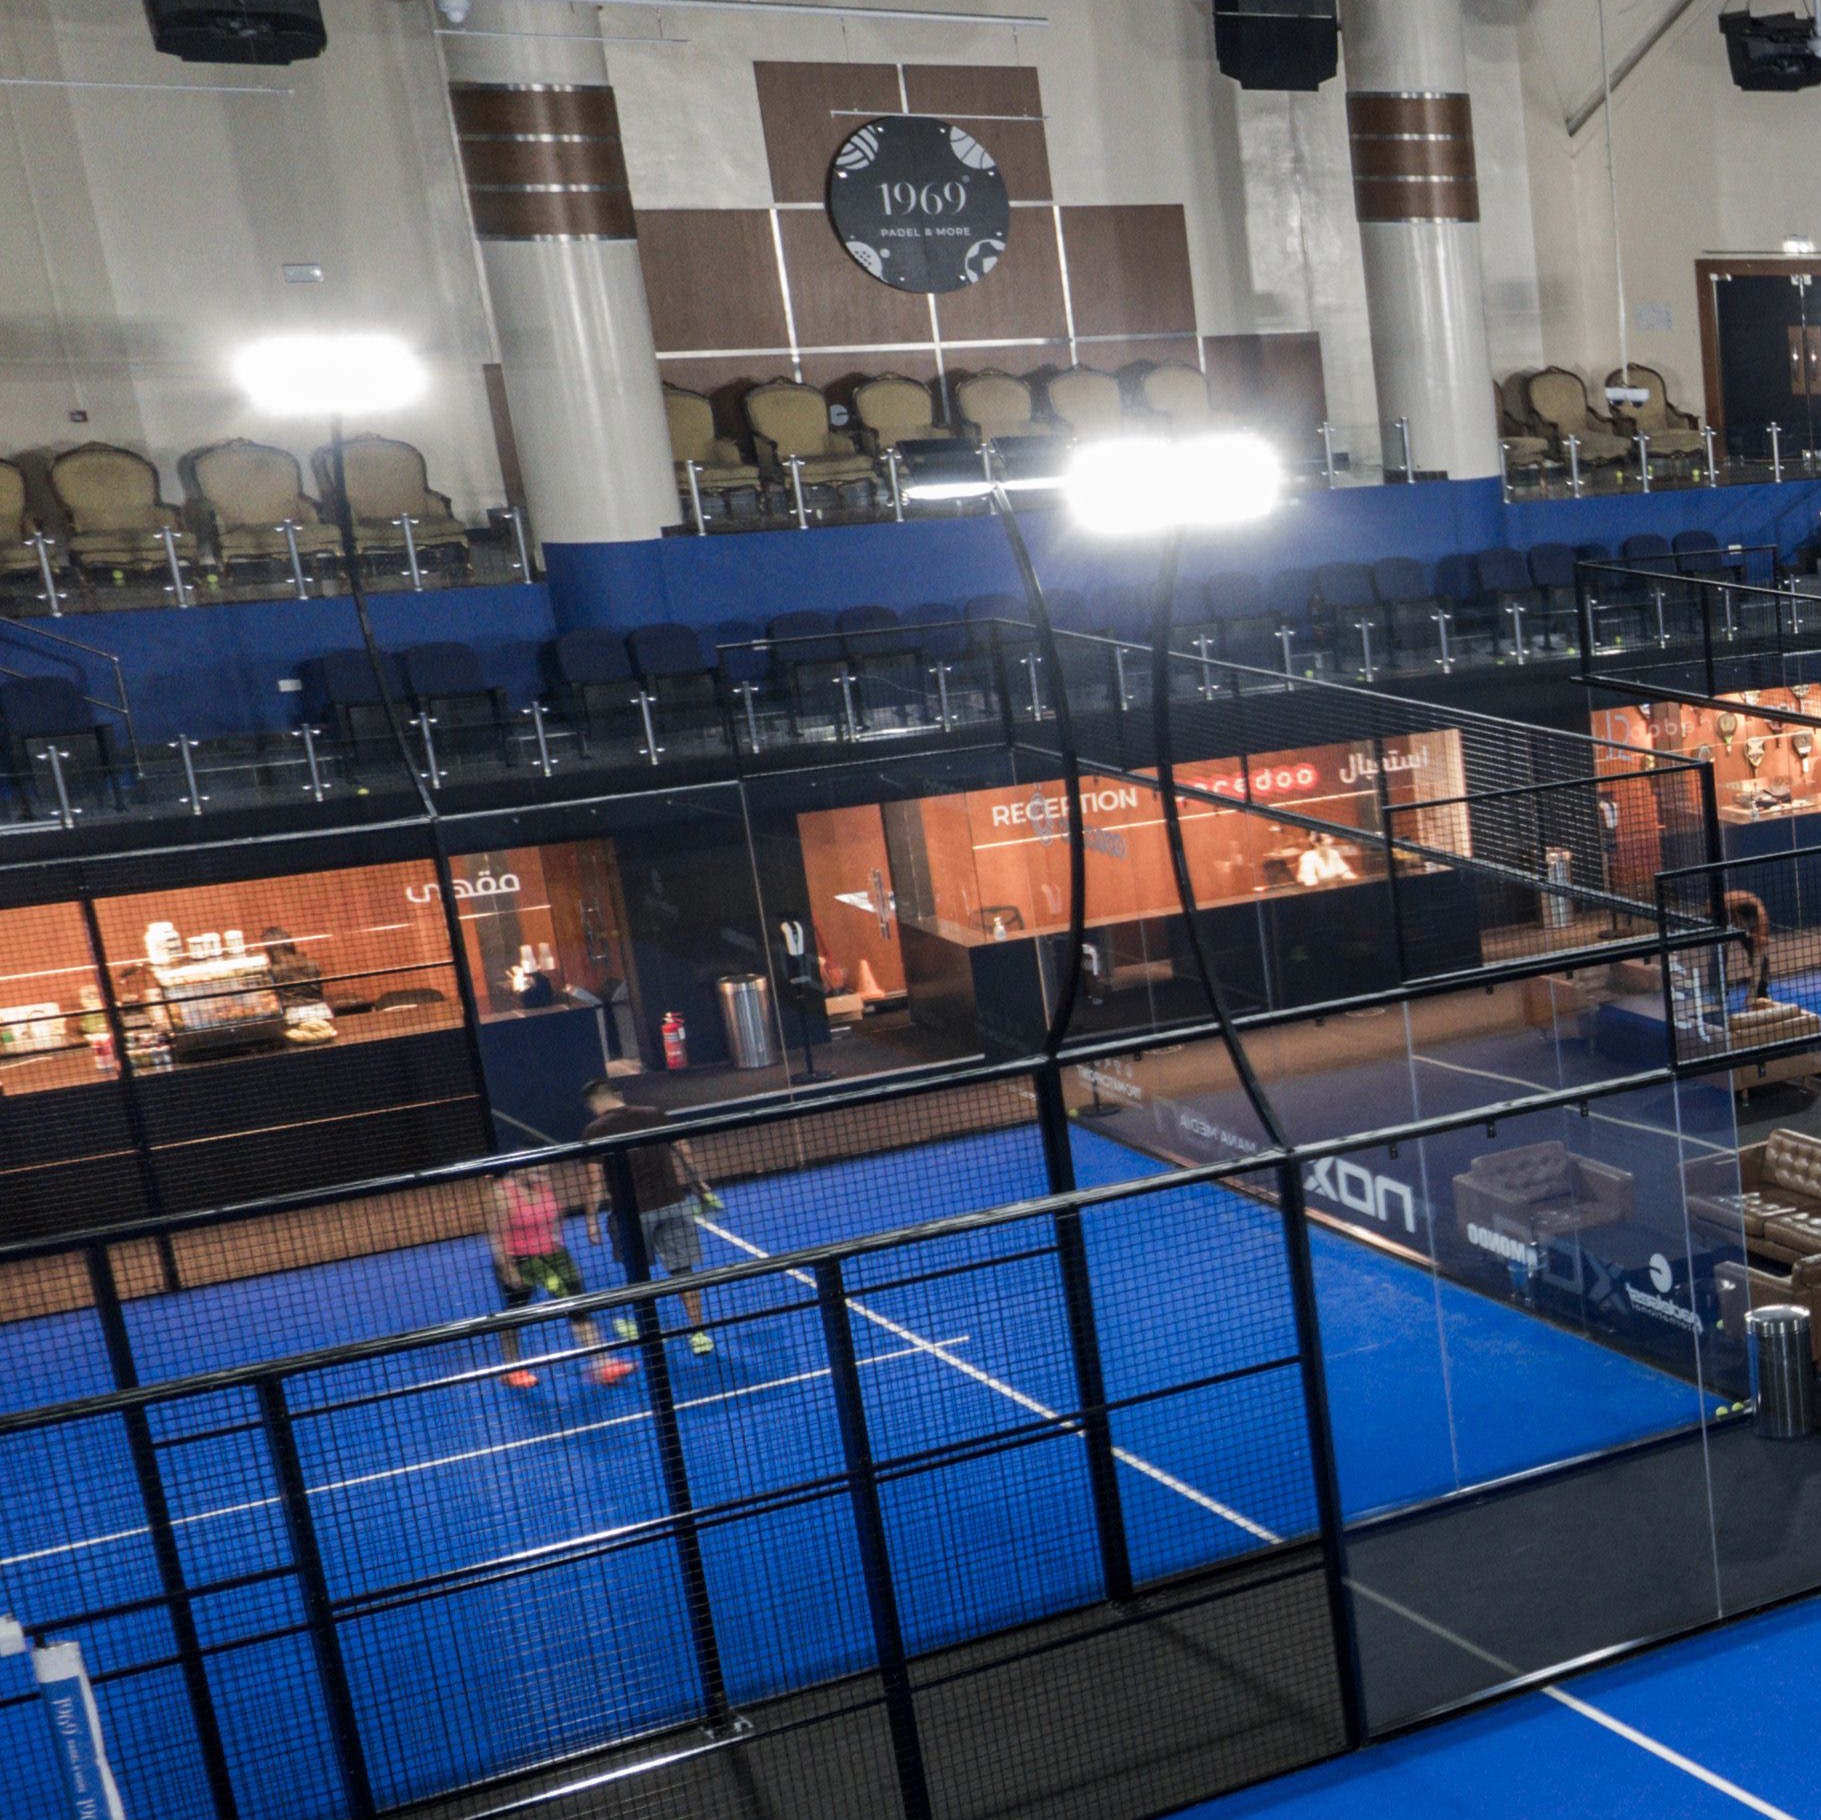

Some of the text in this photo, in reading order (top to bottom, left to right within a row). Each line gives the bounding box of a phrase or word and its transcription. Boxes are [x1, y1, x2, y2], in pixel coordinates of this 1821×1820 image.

[875, 181, 967, 216] 1969
[880, 227, 971, 238] PADEL & MORE
